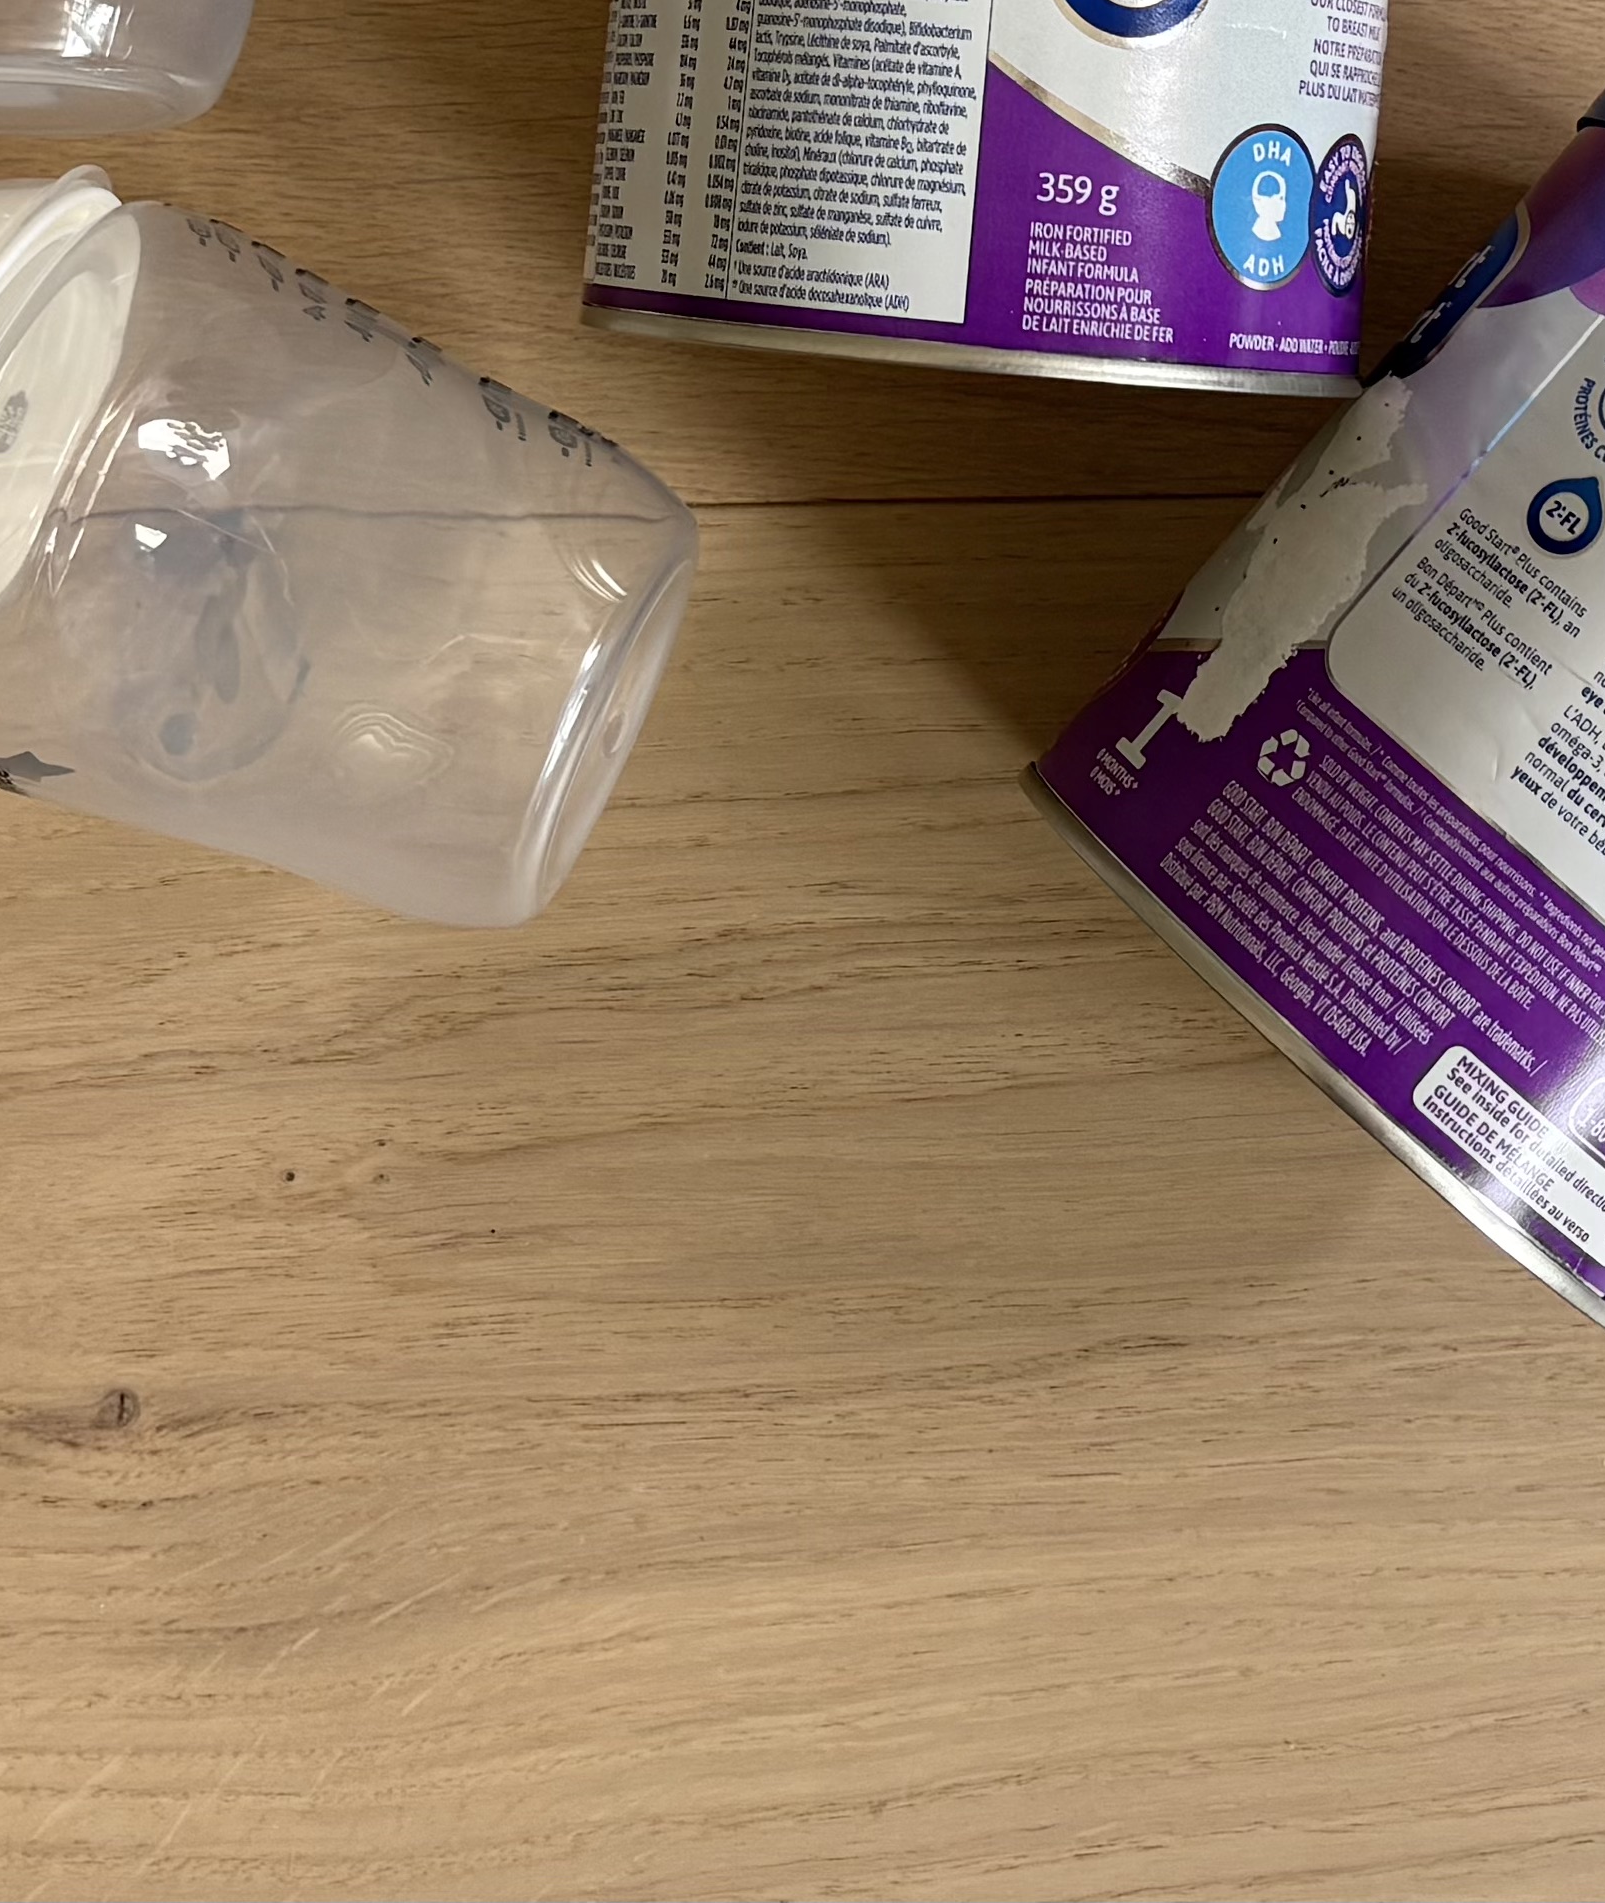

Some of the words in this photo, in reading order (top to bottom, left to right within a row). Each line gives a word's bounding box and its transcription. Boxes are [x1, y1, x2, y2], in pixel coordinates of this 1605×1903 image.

[1327, 16, 1340, 32] TO
[1313, 39, 1345, 57] NOTRE
[1310, 60, 1330, 78] QUI
[1299, 80, 1325, 98] PLUS
[1253, 140, 1292, 167] DHA
[1036, 172, 1092, 205] 359
[1098, 185, 1120, 216] g
[1030, 221, 1064, 240] IRON
[1066, 224, 1132, 246] FORTIFIED
[1028, 239, 1107, 262] MILK-BASED
[1027, 257, 1075, 277] INFANT
[1077, 262, 1139, 283] FORMULA
[1243, 253, 1285, 277] ADH
[1025, 277, 1114, 302] PRÉPARATION
[1117, 286, 1152, 305] POUR
[1023, 296, 1118, 321] NOURRISSONS
[1119, 302, 1128, 321] À
[1130, 307, 1161, 324] BASE
[1022, 314, 1040, 331] DE
[1042, 316, 1070, 334] LAIT
[1073, 319, 1132, 340] ENRICHIE
[1134, 325, 1151, 342] DE
[1152, 327, 1174, 344] FER
[1229, 332, 1275, 351] POWDER
[1279, 337, 1298, 353] ADD
[1574, 378, 1598, 449] PROTÉINES
[1432, 536, 1513, 609] oligosaccharide.
[1457, 506, 1489, 535] Good
[1513, 550, 1541, 579] Plus
[1538, 573, 1588, 618] contains
[1563, 620, 1580, 638] an
[1580, 685, 1604, 708] eye
[1560, 702, 1603, 747] L'ADH,
[1201, 890, 1227, 920] PBM
[1278, 964, 1314, 1009] Georgia,
[1311, 994, 1330, 1017] VT
[1321, 1004, 1355, 1040] 05468
[1347, 1027, 1372, 1057] USA.
[1455, 1053, 1509, 1104] MIXING
[1506, 1097, 1551, 1140] GUIDE
[1431, 1083, 1480, 1129] GUIDE
[1474, 1119, 1499, 1144] DE
[1493, 1135, 1556, 1194] MÉLANGE
[1446, 1066, 1472, 1095] See
[1469, 1087, 1510, 1128] inside
[1507, 1120, 1529, 1145] for
[1526, 1137, 1576, 1183] detailed
[1420, 1092, 1496, 1165] Instructions
[1493, 1156, 1550, 1210] détaillées
[1546, 1204, 1563, 1221] au
[1560, 1215, 1590, 1243] verso
